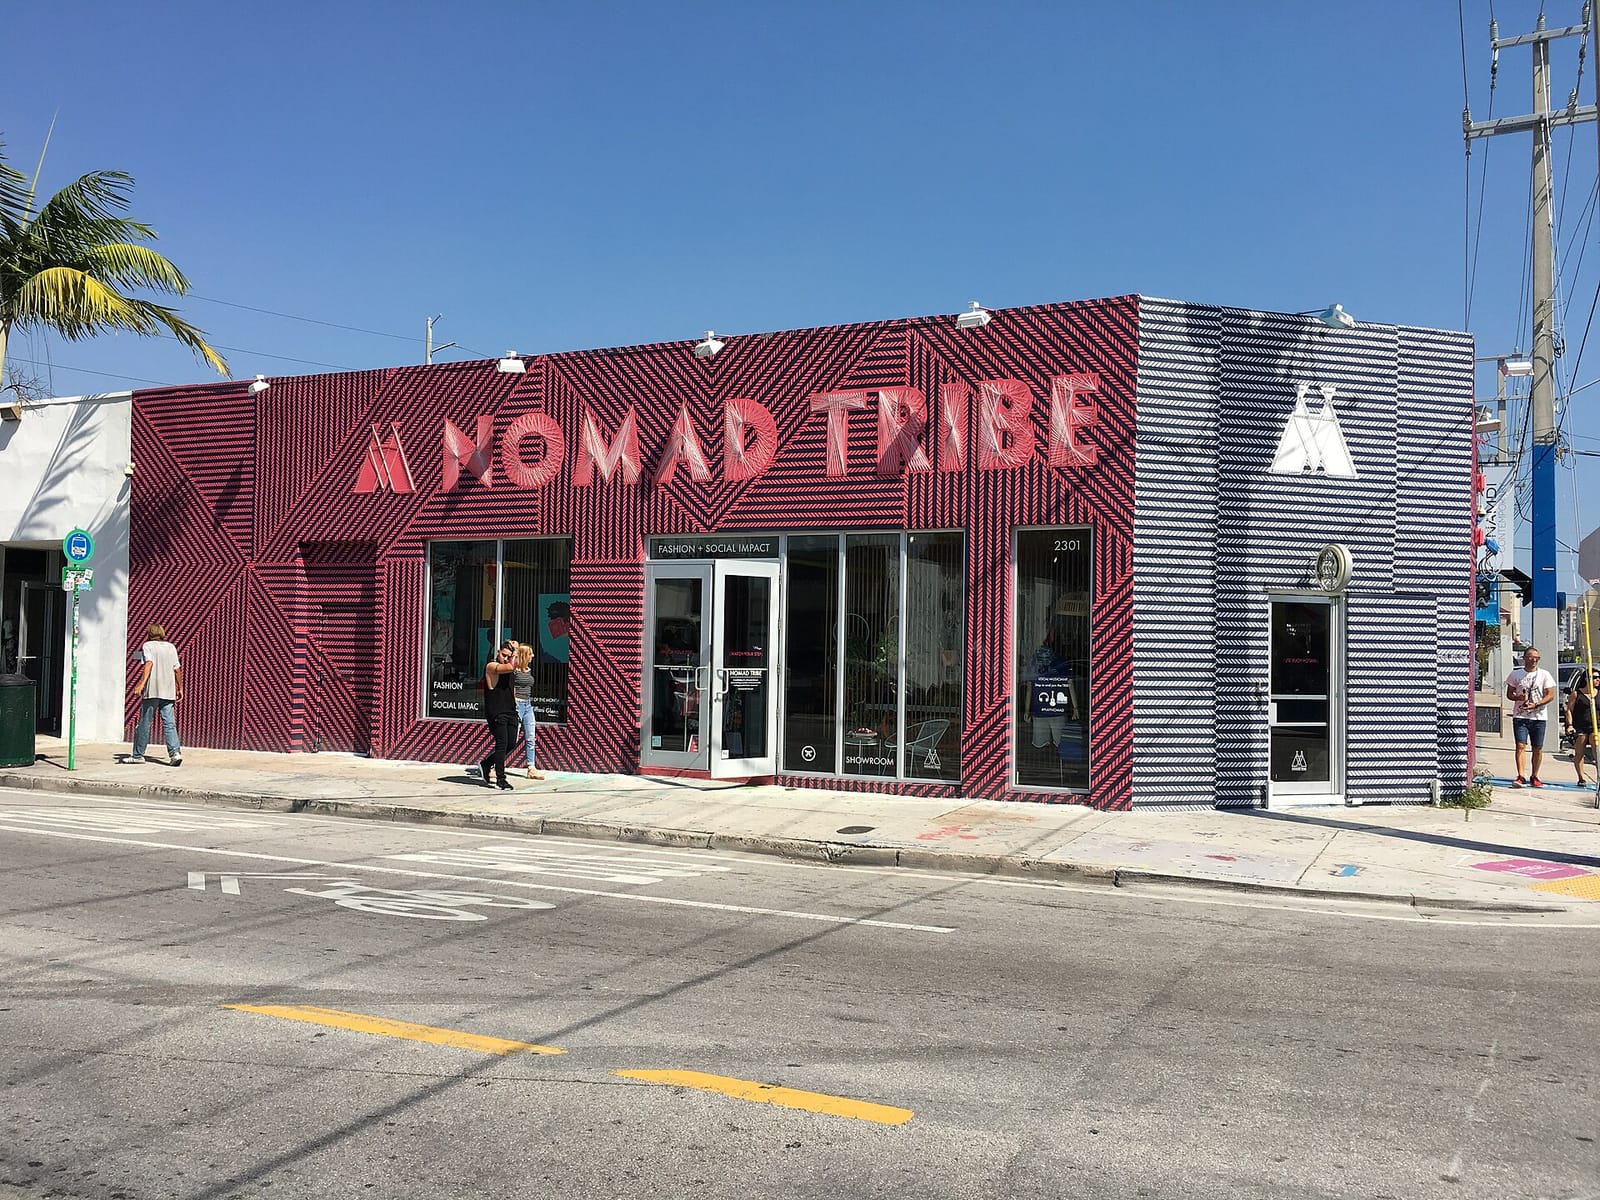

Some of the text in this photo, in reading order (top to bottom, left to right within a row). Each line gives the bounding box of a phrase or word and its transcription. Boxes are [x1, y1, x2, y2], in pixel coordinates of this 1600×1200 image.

[442, 372, 1100, 494] NOMAD TRIBE
[658, 544, 696, 554] FASHION
[705, 543, 737, 553] SOCIAL
[738, 543, 771, 553] IMPACT
[1054, 540, 1080, 551] 2301
[433, 681, 464, 690] FASHION
[432, 700, 457, 710] SOCIAL
[845, 756, 895, 765] SHOWROOM
